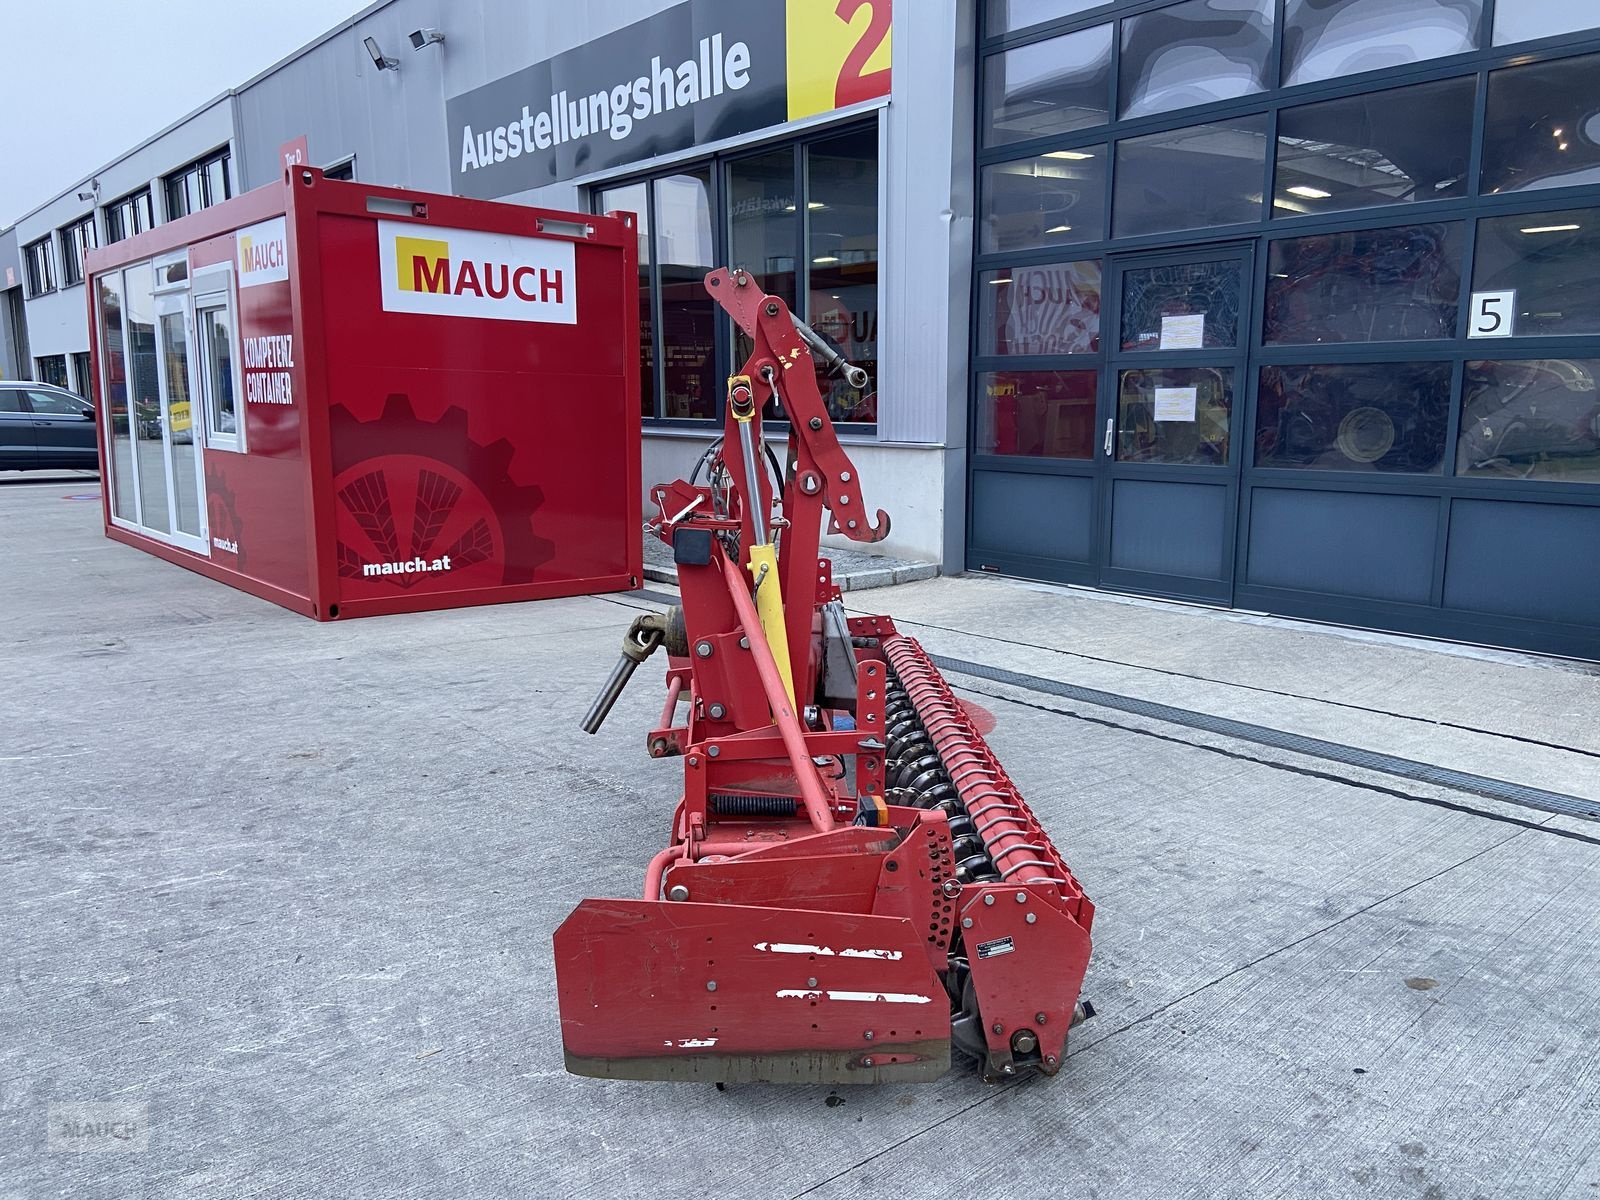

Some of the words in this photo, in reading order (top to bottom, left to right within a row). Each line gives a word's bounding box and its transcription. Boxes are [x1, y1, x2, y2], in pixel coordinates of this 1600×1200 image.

[461, 33, 751, 173] Ausstellungshalle
[834, 0, 892, 109] 2
[244, 239, 284, 273] MAUCH
[412, 255, 564, 304] MAUCH
[1478, 298, 1501, 332] 5
[243, 334, 294, 369] KOMPETENZ
[246, 372, 293, 405] CONTAINER
[363, 555, 451, 576] mauch.at
